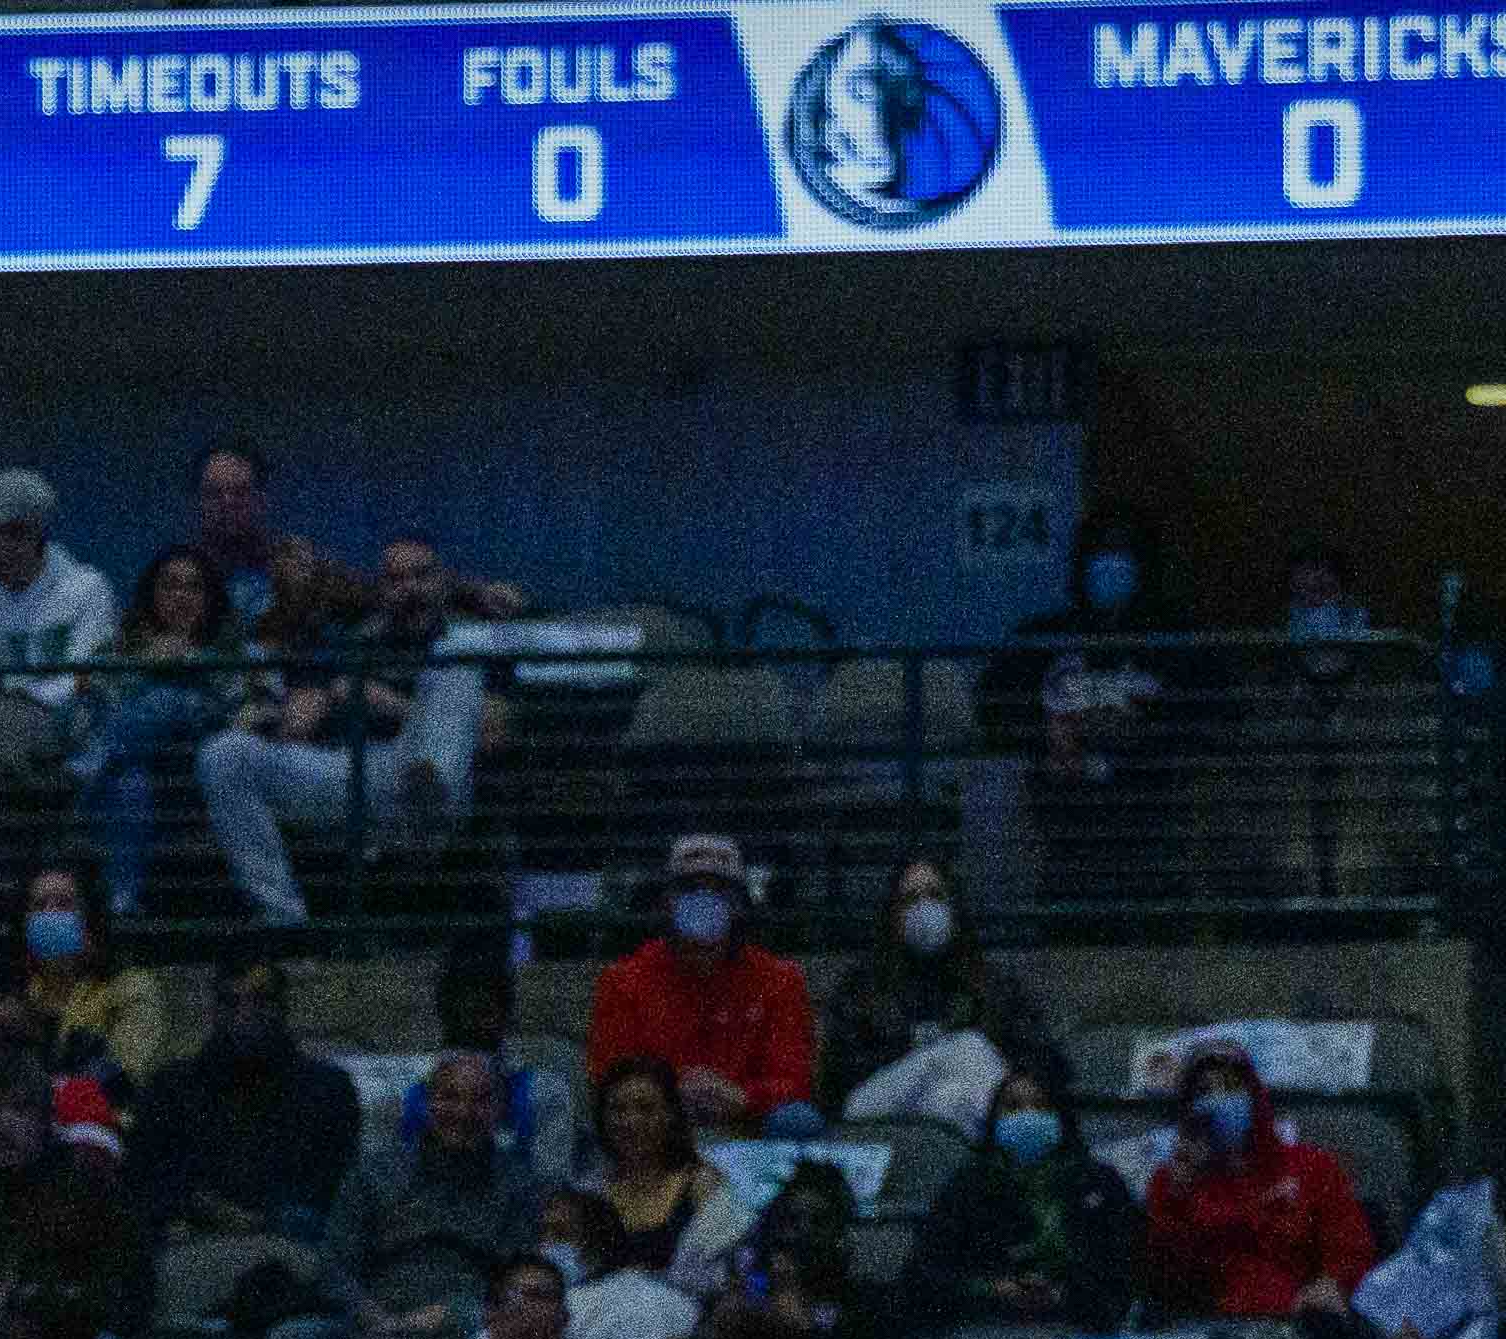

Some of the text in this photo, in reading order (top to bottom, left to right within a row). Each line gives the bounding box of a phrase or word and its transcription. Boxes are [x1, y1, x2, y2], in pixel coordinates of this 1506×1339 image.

[29, 49, 362, 115] TIMEOUTS
[462, 42, 677, 106] FOULS
[164, 134, 225, 231] 7
[532, 125, 603, 223] 0
[1282, 100, 1362, 208] 0
